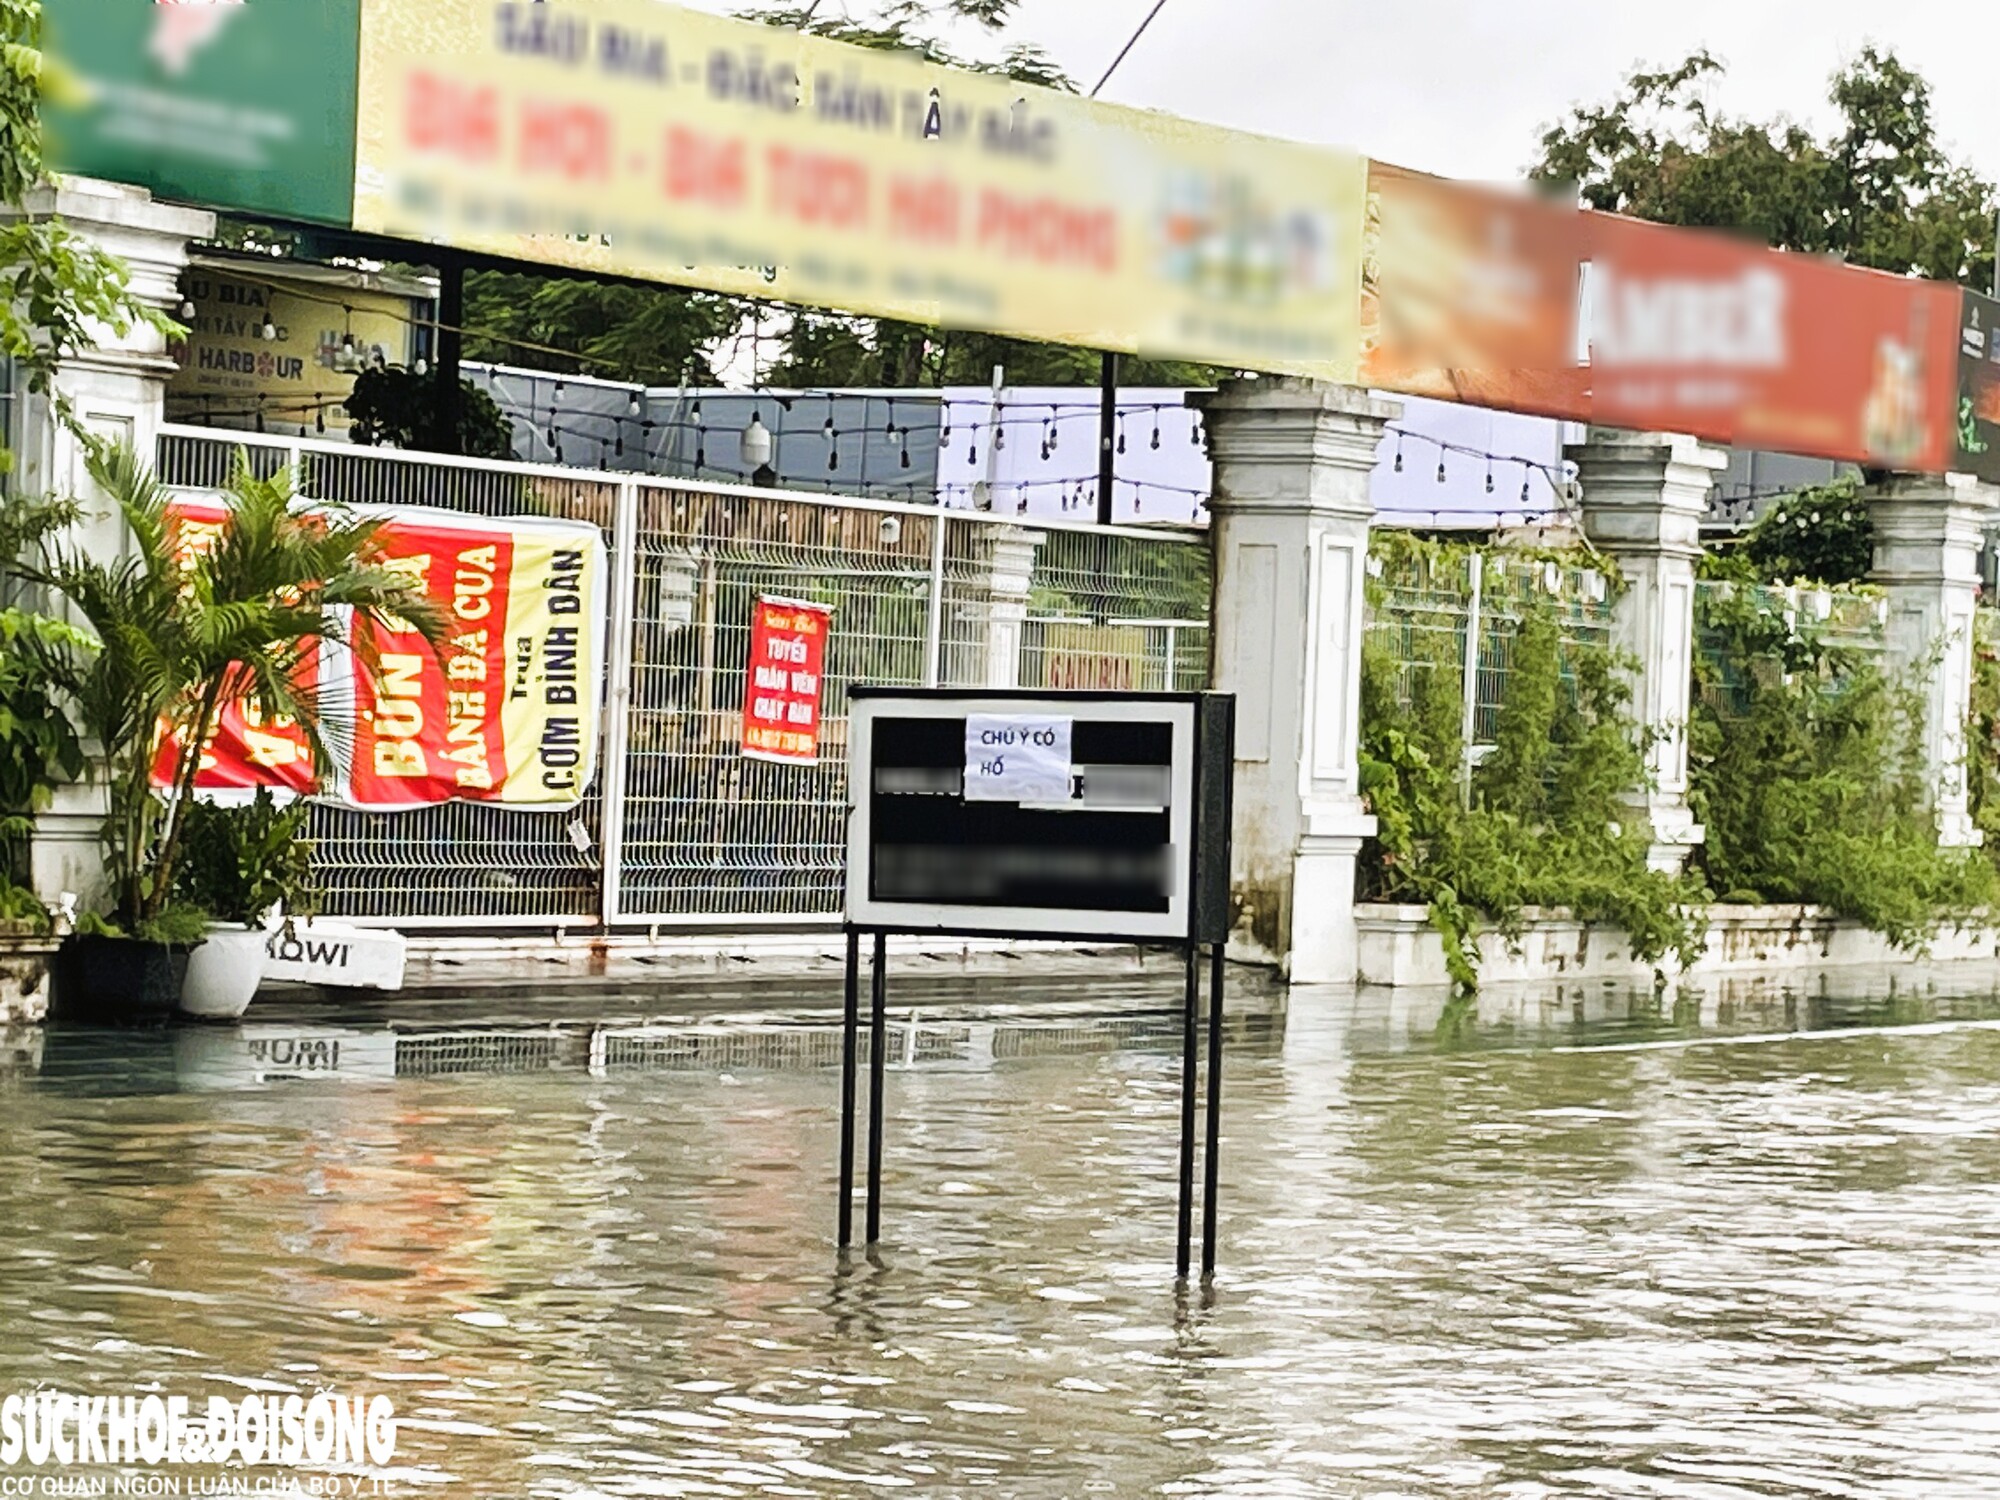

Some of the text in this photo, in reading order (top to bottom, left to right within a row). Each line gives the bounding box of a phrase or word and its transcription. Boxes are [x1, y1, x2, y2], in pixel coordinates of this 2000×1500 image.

[251, 321, 289, 343] BC
[452, 543, 497, 622] CUA
[536, 549, 584, 790] CƠM BÌNH DÂN
[362, 652, 428, 777] BÚN
[981, 726, 1055, 746] CHÚ Ý CÓ
